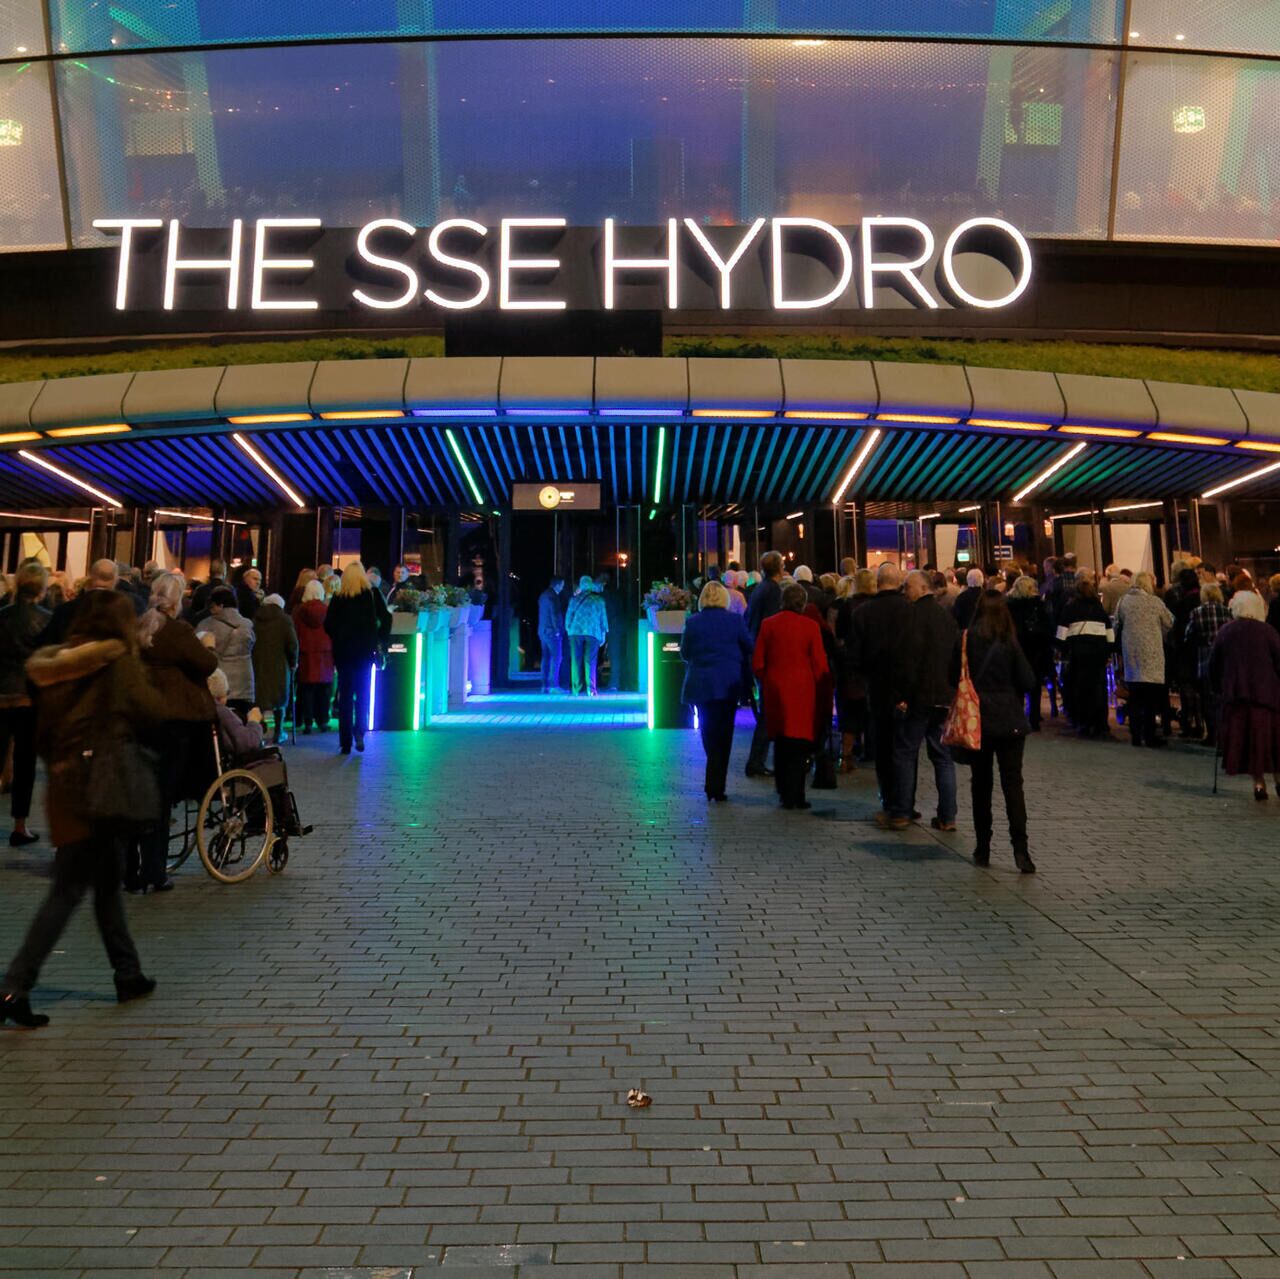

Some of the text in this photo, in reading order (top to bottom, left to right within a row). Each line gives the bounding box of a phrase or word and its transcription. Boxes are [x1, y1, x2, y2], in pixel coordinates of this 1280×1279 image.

[92, 215, 1033, 310] THE SSE HYDRO
